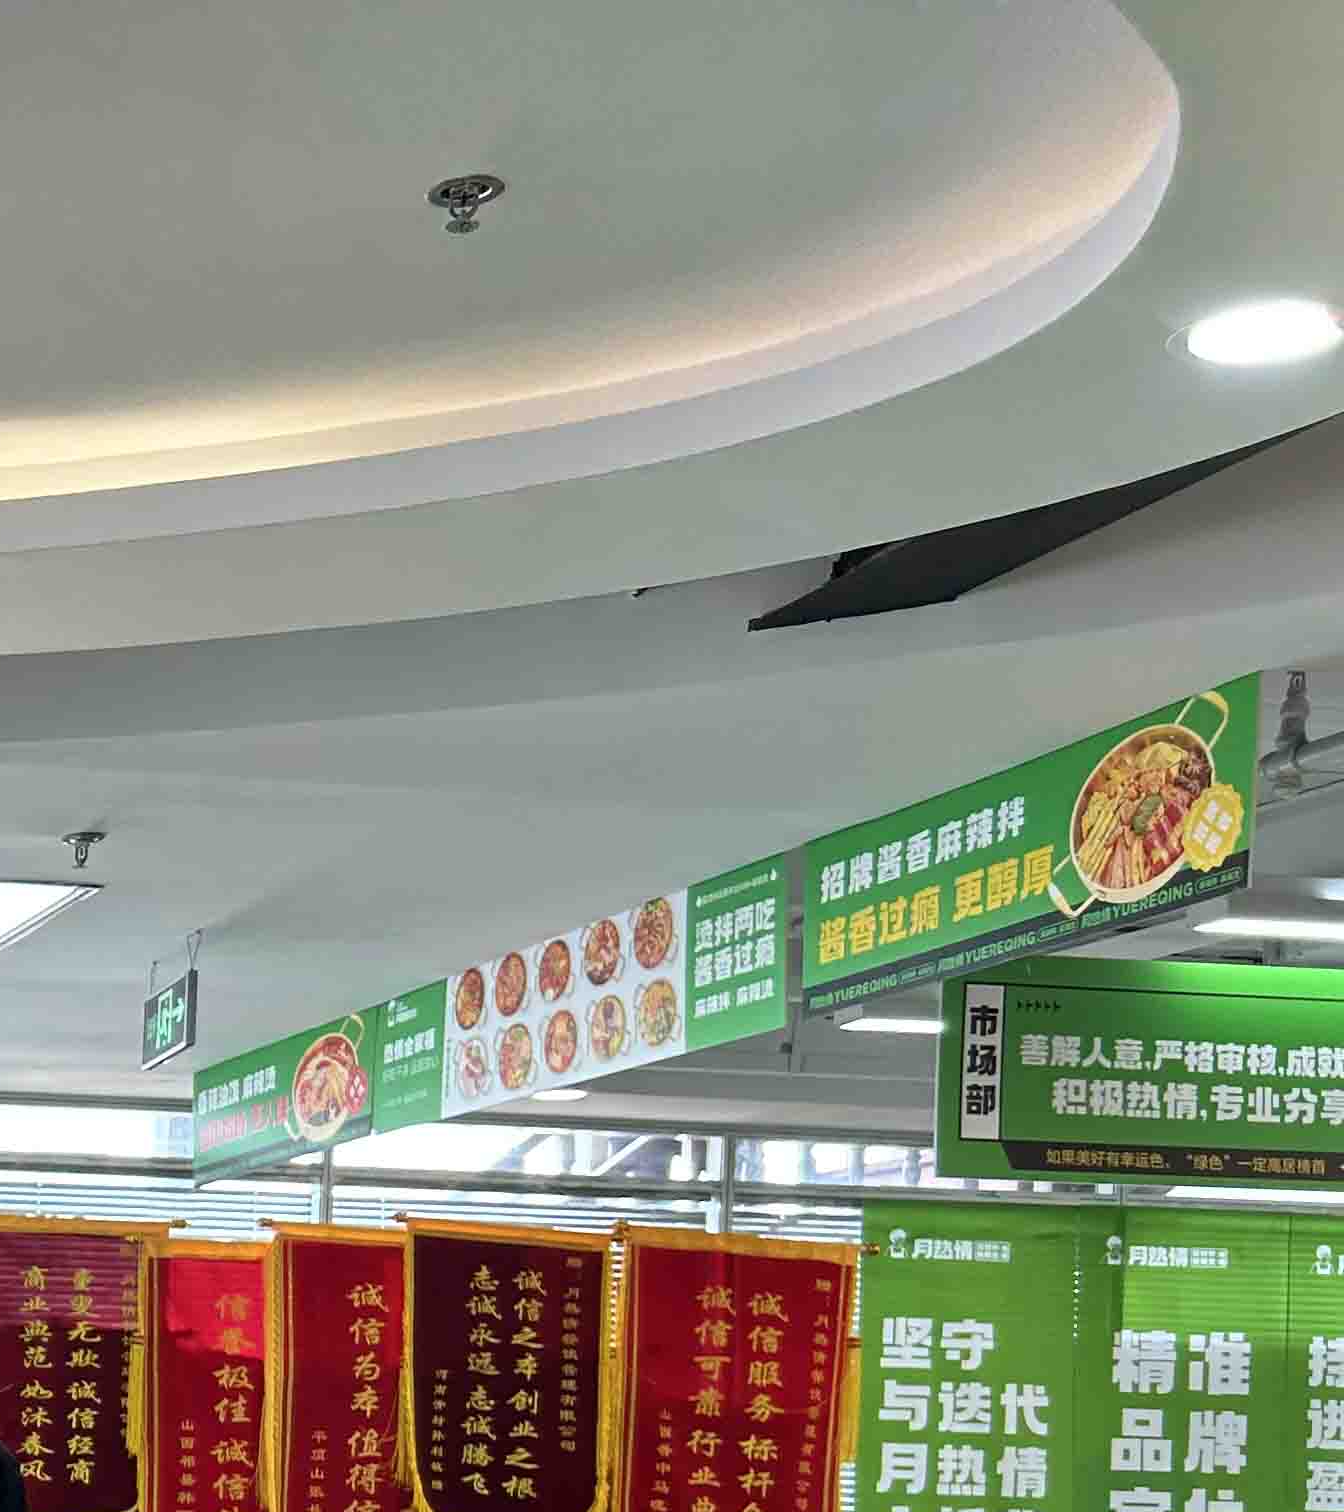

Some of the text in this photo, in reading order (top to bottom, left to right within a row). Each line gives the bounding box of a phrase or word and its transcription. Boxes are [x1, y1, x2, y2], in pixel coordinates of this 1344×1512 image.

[820, 796, 1025, 903] 招牌酱香麻辣拌
[819, 845, 1055, 964] 酱香过瘾 更醇厚
[965, 932, 1036, 964] YUEREQING
[832, 974, 898, 1004] YUEREQING
[966, 1005, 999, 1116] 市场部
[16, 1265, 54, 1481] 商业典范 如沐春风
[347, 1282, 389, 1417] 诚信为本
[502, 1270, 548, 1498] 诚信之本 创业之根
[744, 1292, 790, 1423] 诚信服务
[880, 1317, 995, 1371] 坚守
[1112, 1330, 1251, 1395] 精准
[66, 1380, 101, 1485] 诚信经商
[878, 1380, 1049, 1436] 与迭代
[1111, 1408, 1248, 1474] 品牌
[876, 1442, 1048, 1498] 月热情
